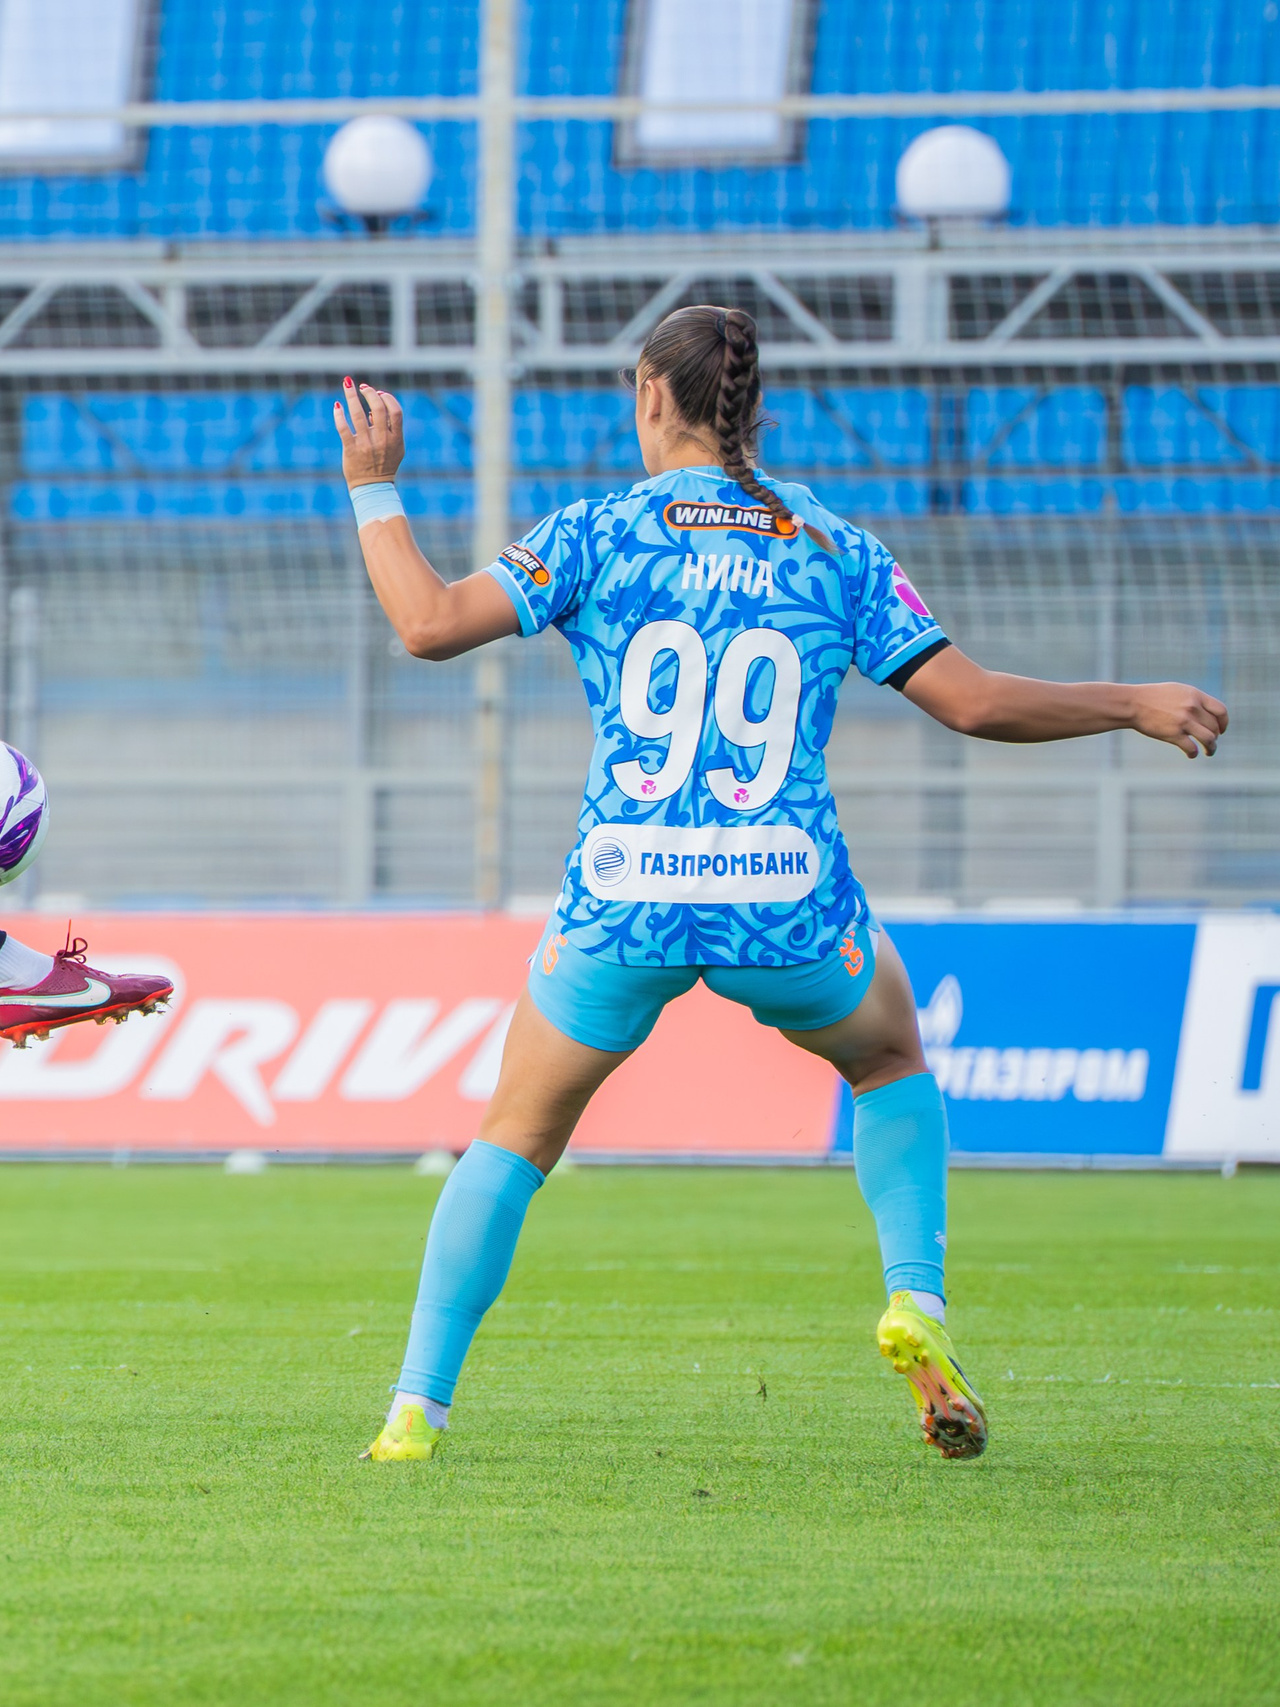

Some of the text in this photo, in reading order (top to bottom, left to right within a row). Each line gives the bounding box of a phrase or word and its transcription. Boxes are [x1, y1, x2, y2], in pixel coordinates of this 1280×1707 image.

[675, 506, 772, 530] WINLINE
[501, 547, 541, 571] ININE
[681, 552, 774, 598] НИНА
[610, 619, 802, 810] 99
[639, 851, 810, 877] ГАЗПРОМБАНК
